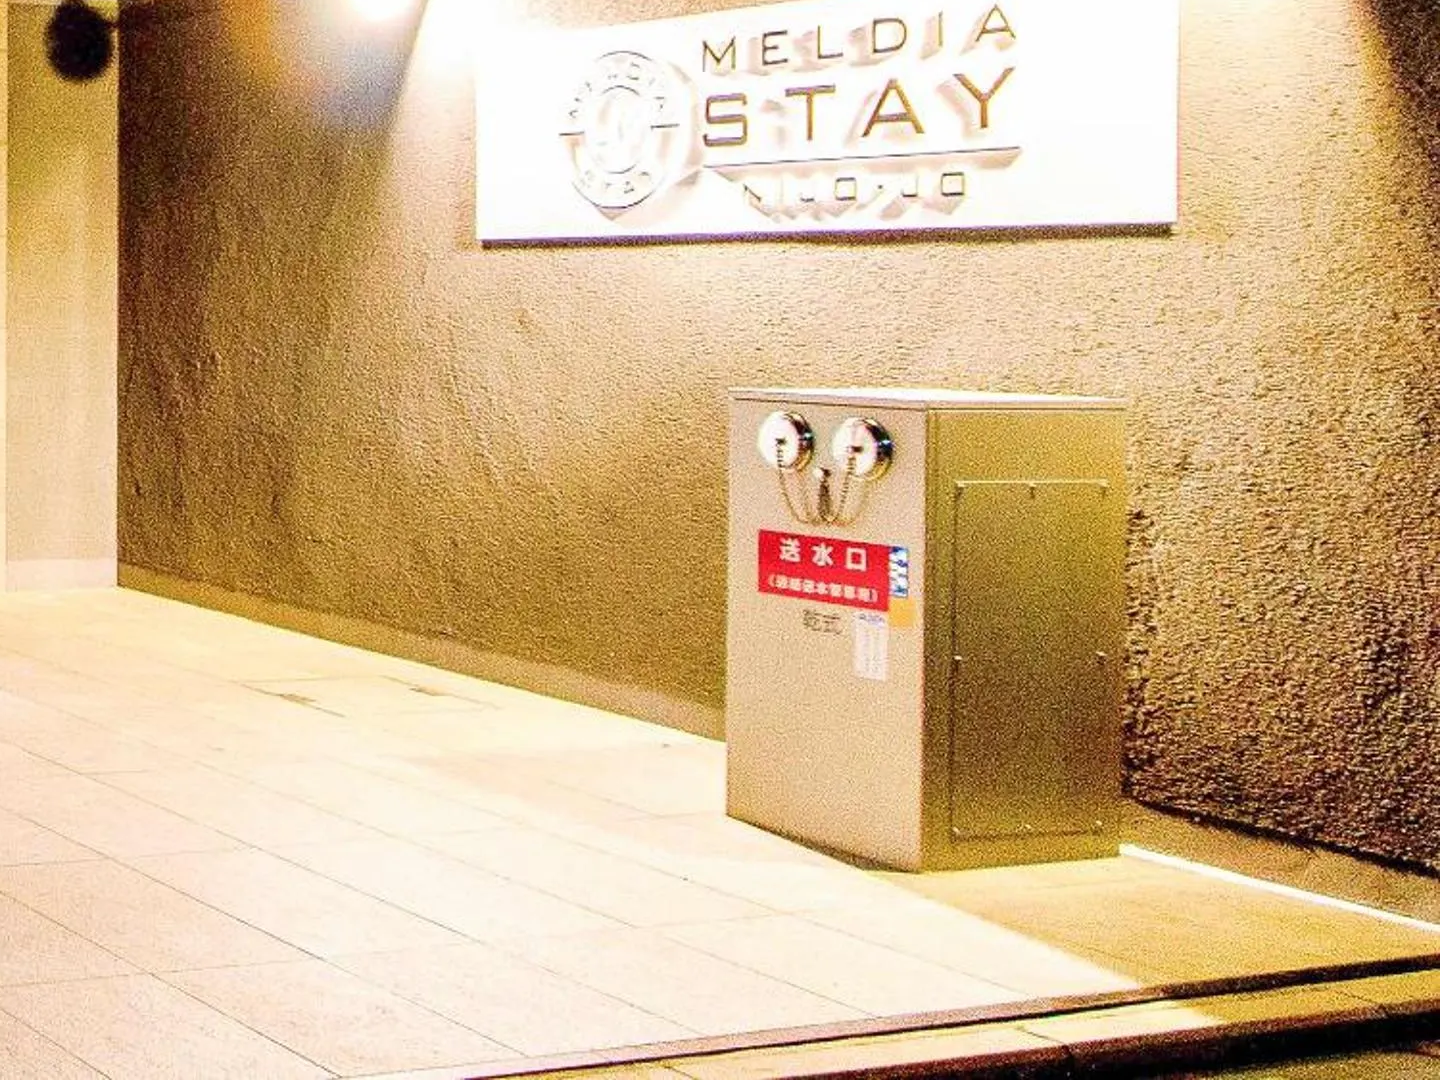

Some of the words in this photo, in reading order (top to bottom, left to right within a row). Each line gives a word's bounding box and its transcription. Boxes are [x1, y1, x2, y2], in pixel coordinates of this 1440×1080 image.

[701, 3, 1016, 74] MELDIA
[702, 66, 1016, 147] STAY
[778, 536, 868, 572] 送水口
